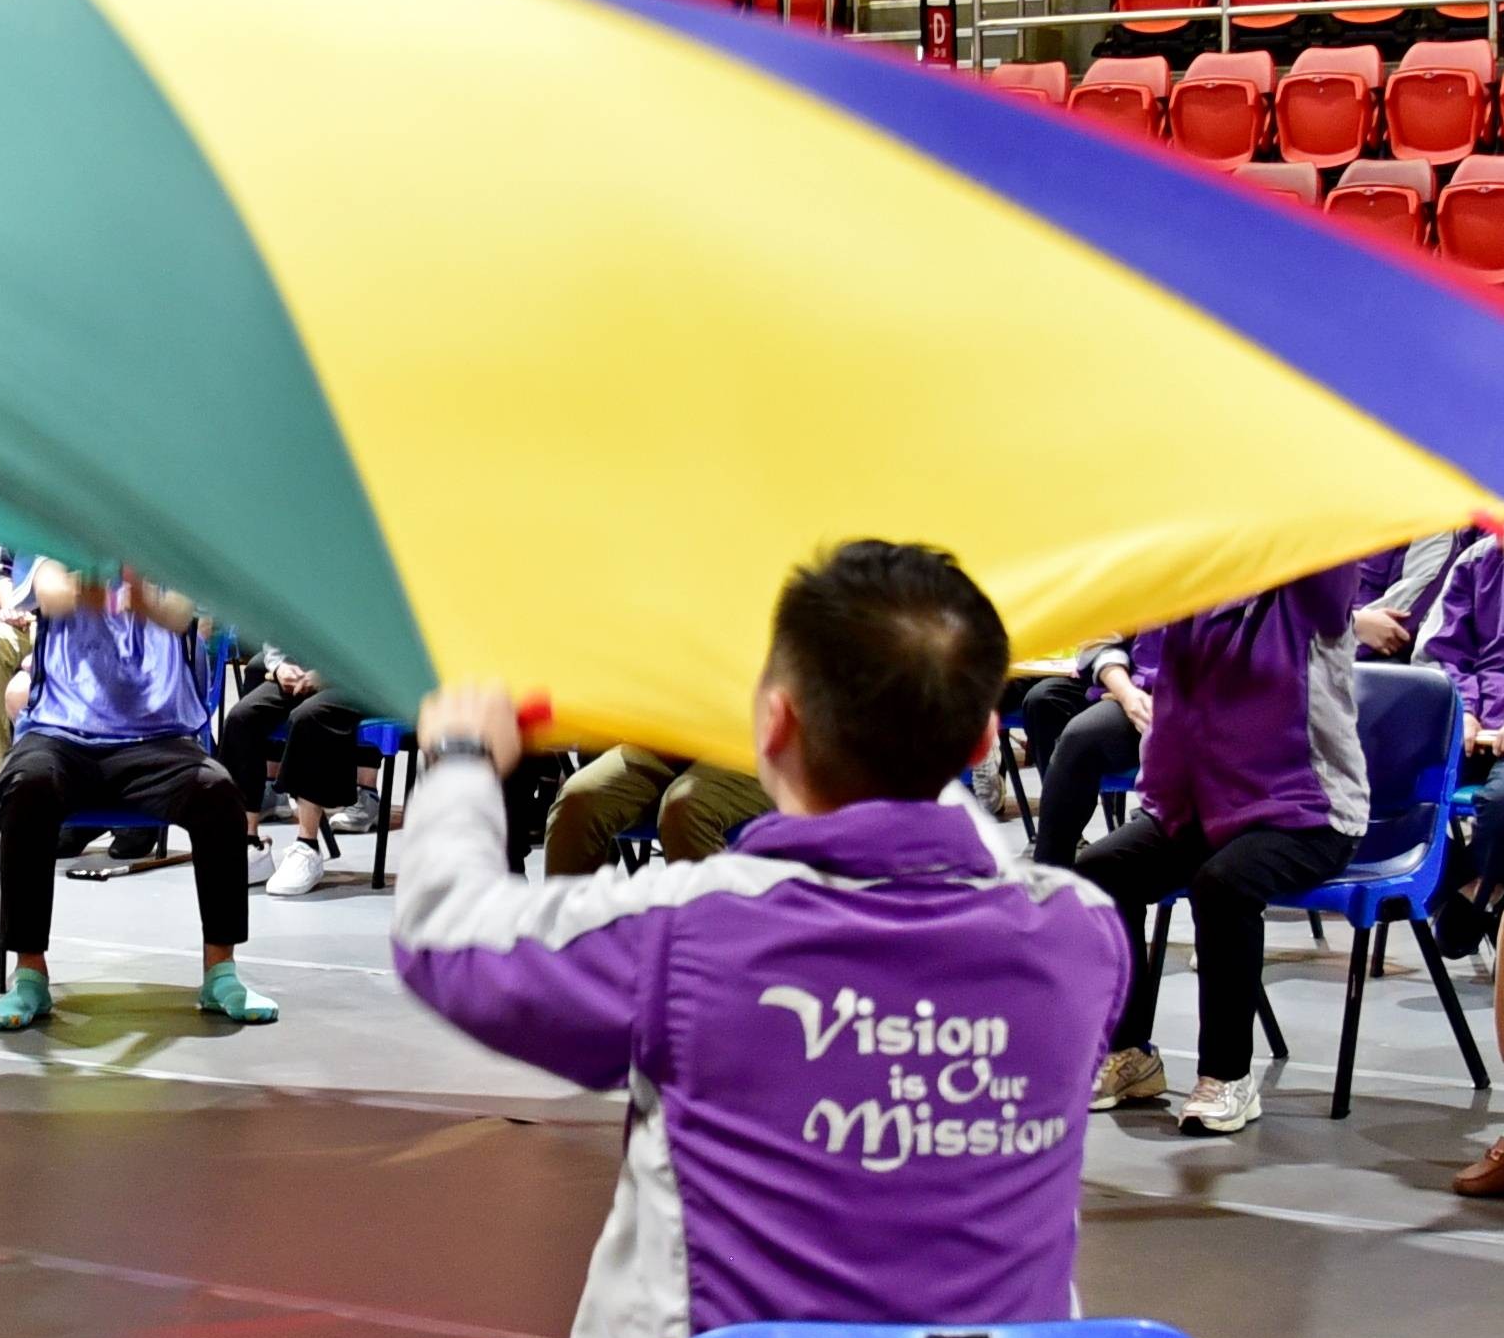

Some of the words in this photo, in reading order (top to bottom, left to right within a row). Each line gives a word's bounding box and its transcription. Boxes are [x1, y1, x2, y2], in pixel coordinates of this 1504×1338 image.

[933, 11, 946, 45] D
[758, 985, 1009, 1061] Vision
[889, 1064, 928, 1100] is
[937, 1057, 1029, 1105] Our
[802, 1098, 1068, 1173] Mission
